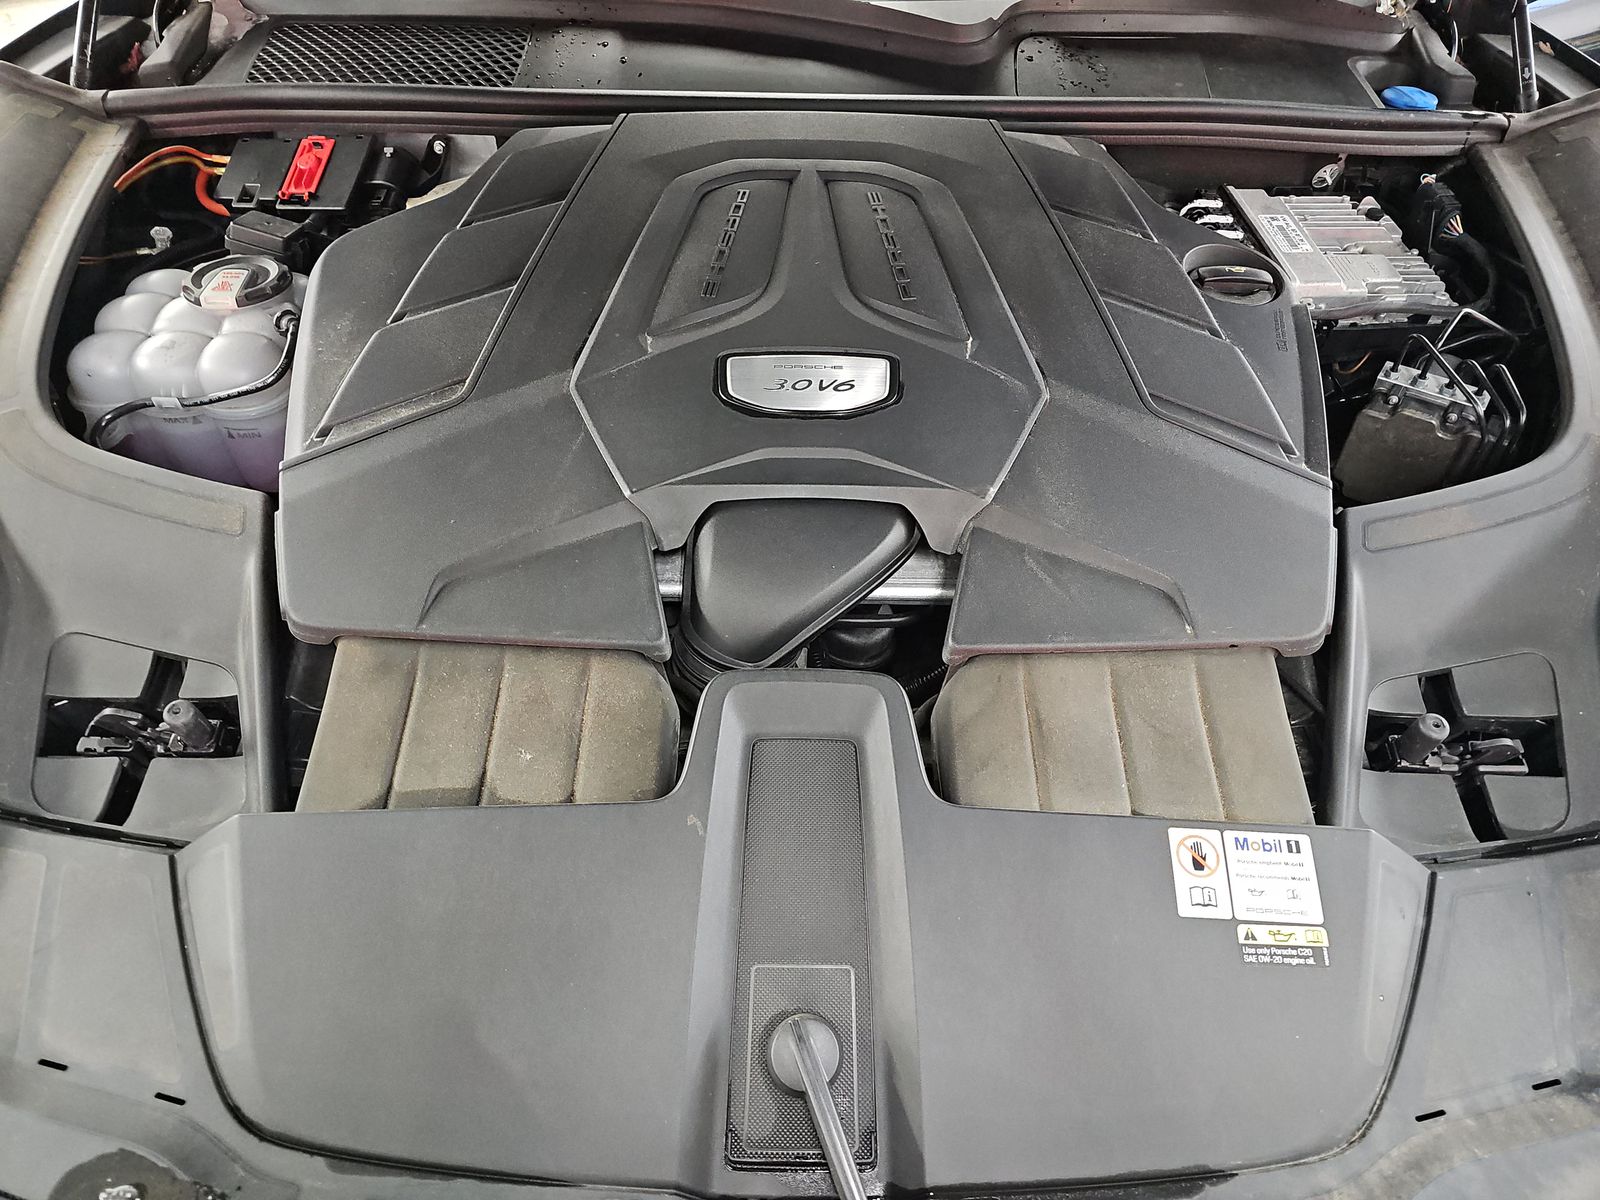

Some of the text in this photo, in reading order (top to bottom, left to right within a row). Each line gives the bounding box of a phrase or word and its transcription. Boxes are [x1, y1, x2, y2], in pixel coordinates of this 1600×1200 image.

[700, 188, 750, 298] PORSCHE
[866, 191, 917, 301] PORSCHE
[763, 378, 856, 392] 3.0 V6
[236, 431, 262, 439] MIN
[1234, 837, 1301, 854] Mobil 1
[1242, 946, 1313, 956] Use only Porsche C20
[1243, 955, 1258, 963] SAE
[1258, 955, 1283, 964] 0W-20
[1283, 957, 1305, 966] engine
